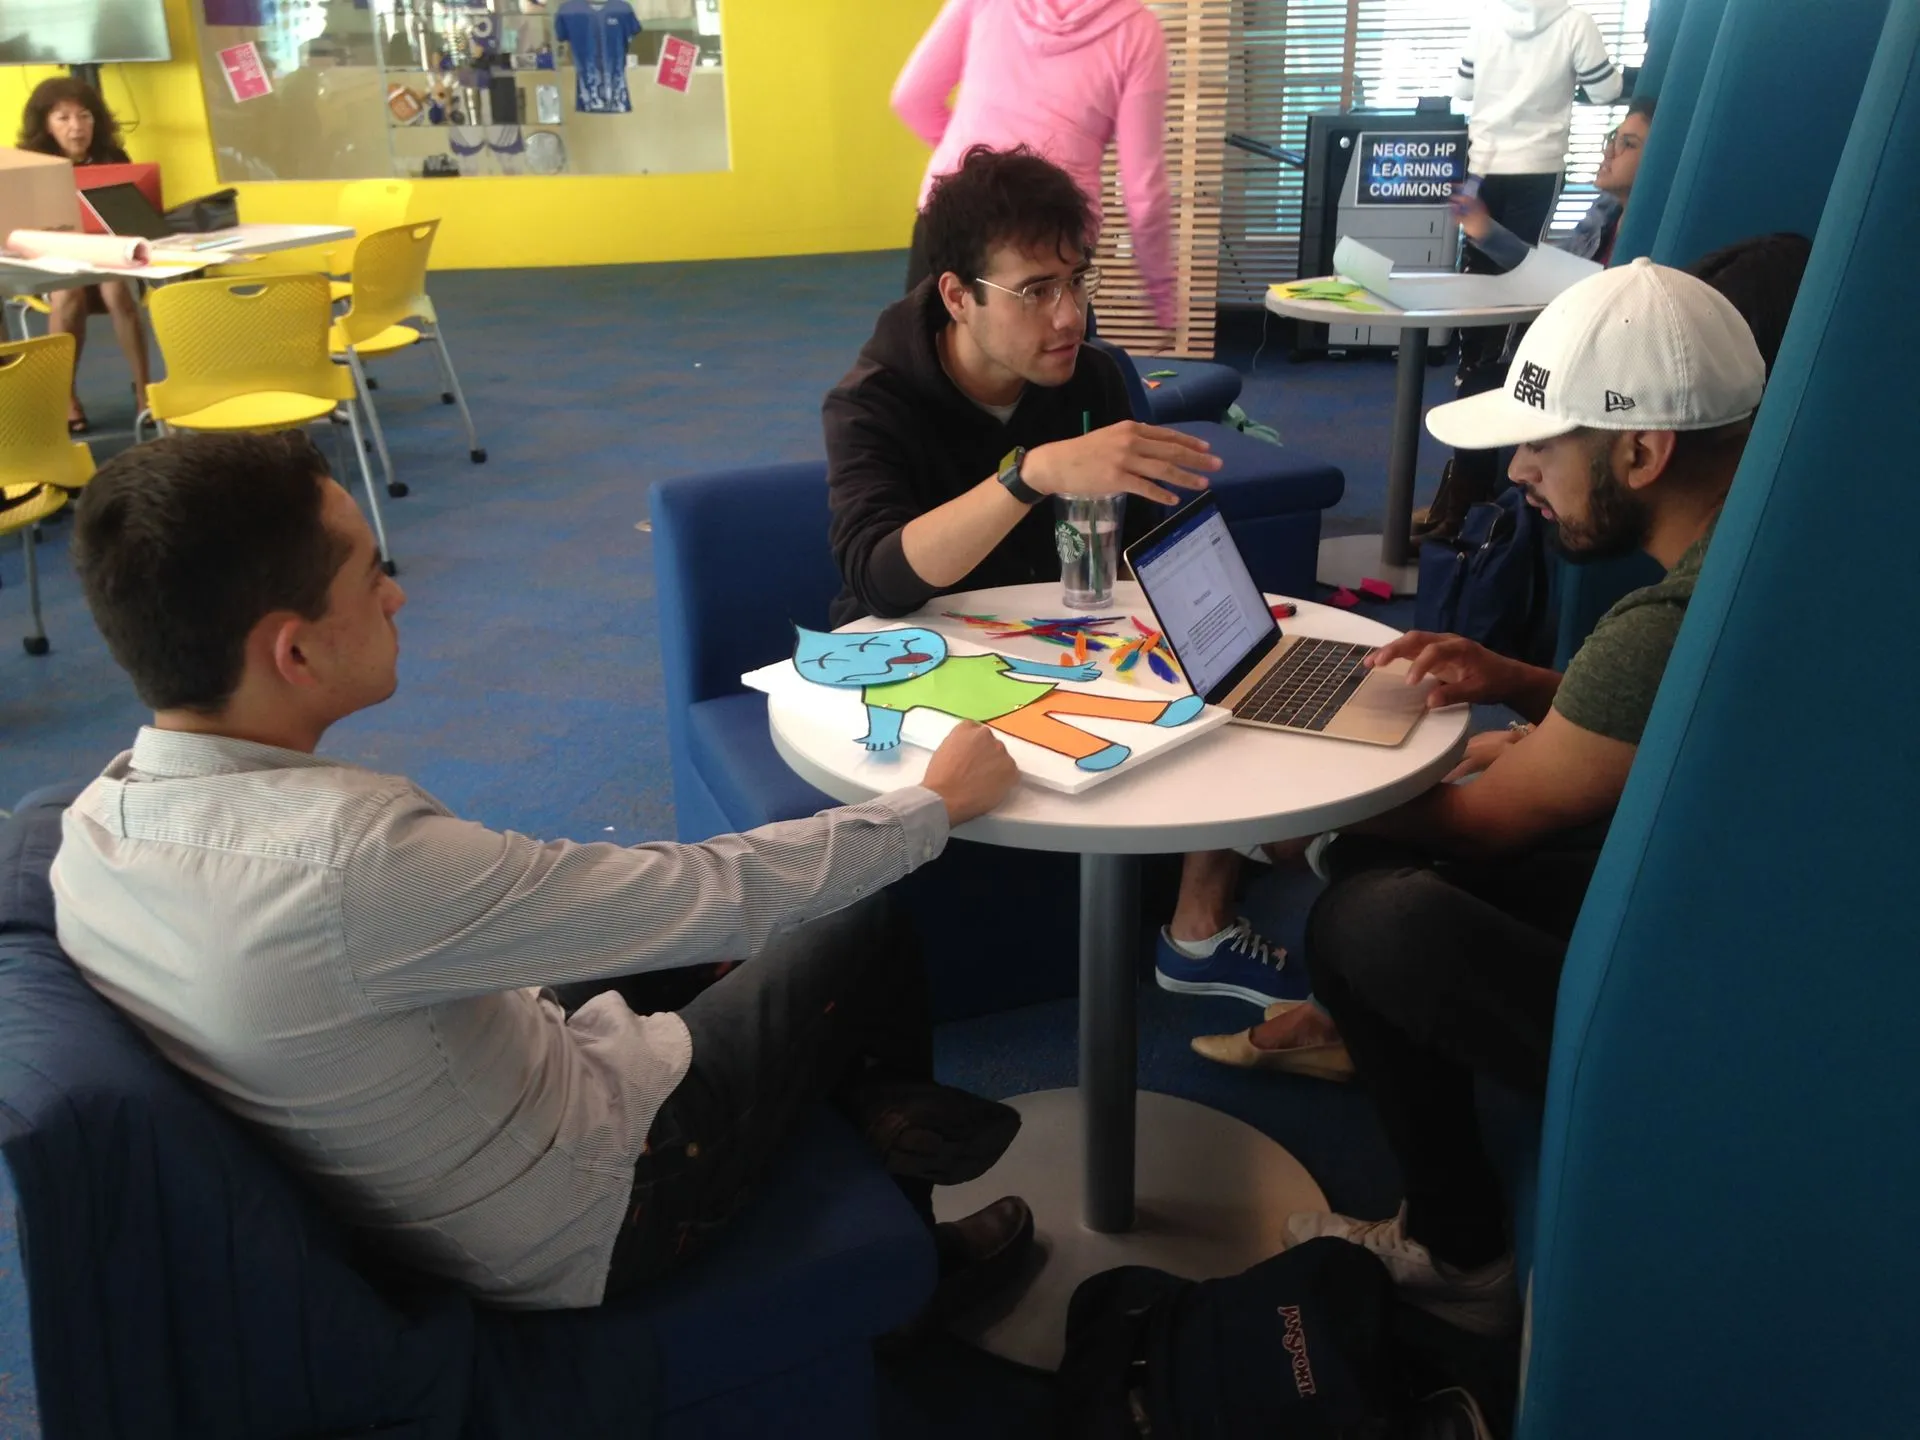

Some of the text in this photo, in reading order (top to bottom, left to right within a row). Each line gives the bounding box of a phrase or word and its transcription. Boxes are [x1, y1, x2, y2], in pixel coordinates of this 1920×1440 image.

[1372, 142, 1457, 157] NEGRO HP
[1371, 162, 1453, 177] LEARNING
[1369, 182, 1453, 197] COMMONS
[1519, 360, 1551, 390] NEW
[1513, 379, 1546, 410] ERA
[1277, 1305, 1317, 1398] JANSPORT
